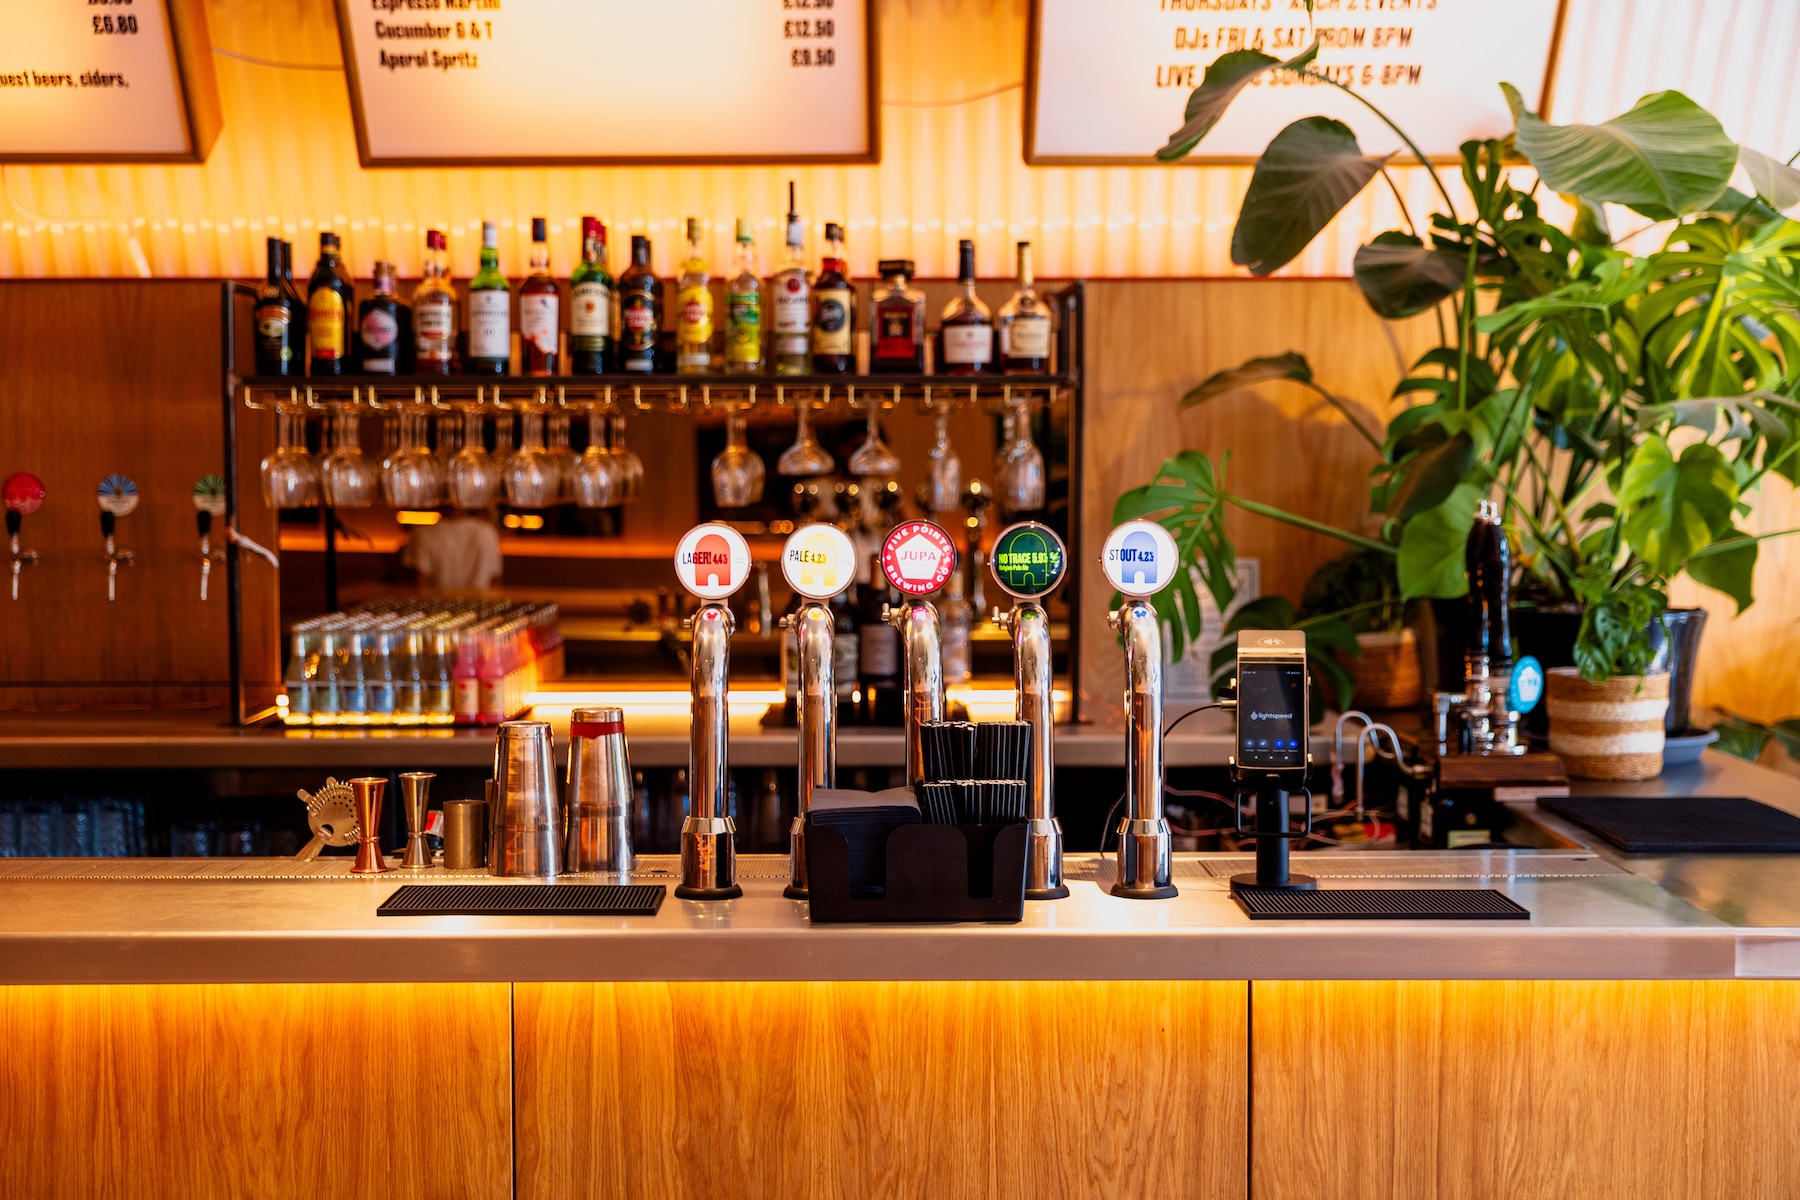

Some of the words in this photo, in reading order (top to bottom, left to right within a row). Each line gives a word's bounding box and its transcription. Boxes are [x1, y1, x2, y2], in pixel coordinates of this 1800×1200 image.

[375, 19, 450, 39] Cucumber
[471, 21, 481, 39] &
[485, 22, 492, 39] T
[784, 20, 834, 38] £12.50
[1174, 27, 1208, 49] DJs
[1216, 27, 1247, 50] FRI
[1252, 27, 1264, 51] &
[1272, 27, 1306, 49] SAT
[380, 50, 428, 71] Aperol
[432, 51, 479, 71] Spritz
[0, 71, 30, 88] uest
[32, 69, 78, 89] beers,
[80, 69, 129, 89] ciders,
[1156, 65, 1195, 88] LIVE
[887, 528, 909, 551] FIVE
[912, 525, 950, 553] POINTS
[682, 551, 711, 565] LAGER!
[713, 553, 728, 564] 4.4%
[790, 549, 809, 562] PALE
[811, 553, 827, 564] 4.2%
[901, 550, 936, 561] JUPA
[998, 553, 1008, 565] NO
[1009, 552, 1031, 564] TRACE
[1110, 548, 1137, 562] STOUT
[1138, 551, 1154, 562] 4.2%
[887, 565, 934, 592] BREWING
[1258, 712, 1293, 720] lightspeed
